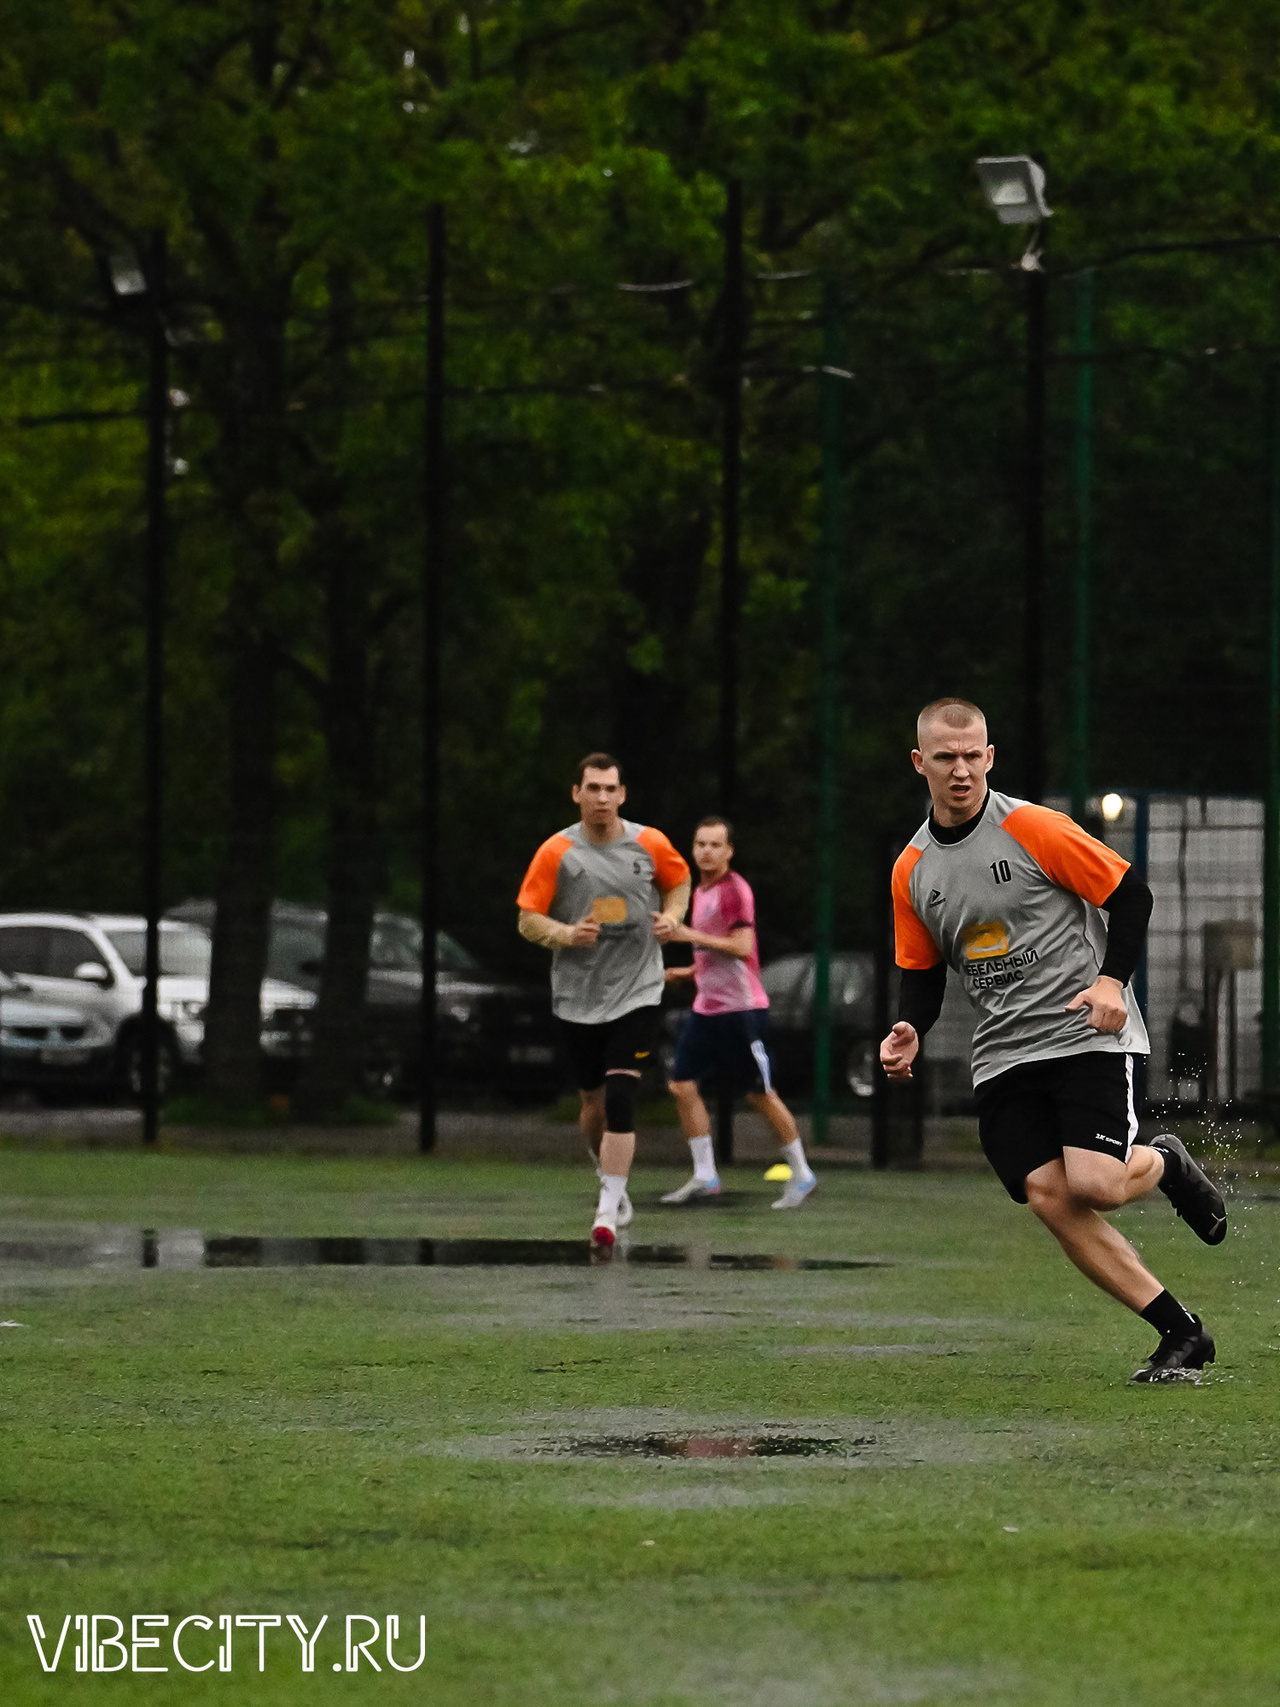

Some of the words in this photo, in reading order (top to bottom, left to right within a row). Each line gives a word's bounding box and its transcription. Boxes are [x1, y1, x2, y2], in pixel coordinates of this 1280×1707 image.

[990, 859, 1012, 884] 10
[965, 947, 1040, 976] ЕБЕЛЬНЫЙ
[973, 970, 1024, 990] СЕРВИС
[1105, 1137, 1123, 1147] SPORT
